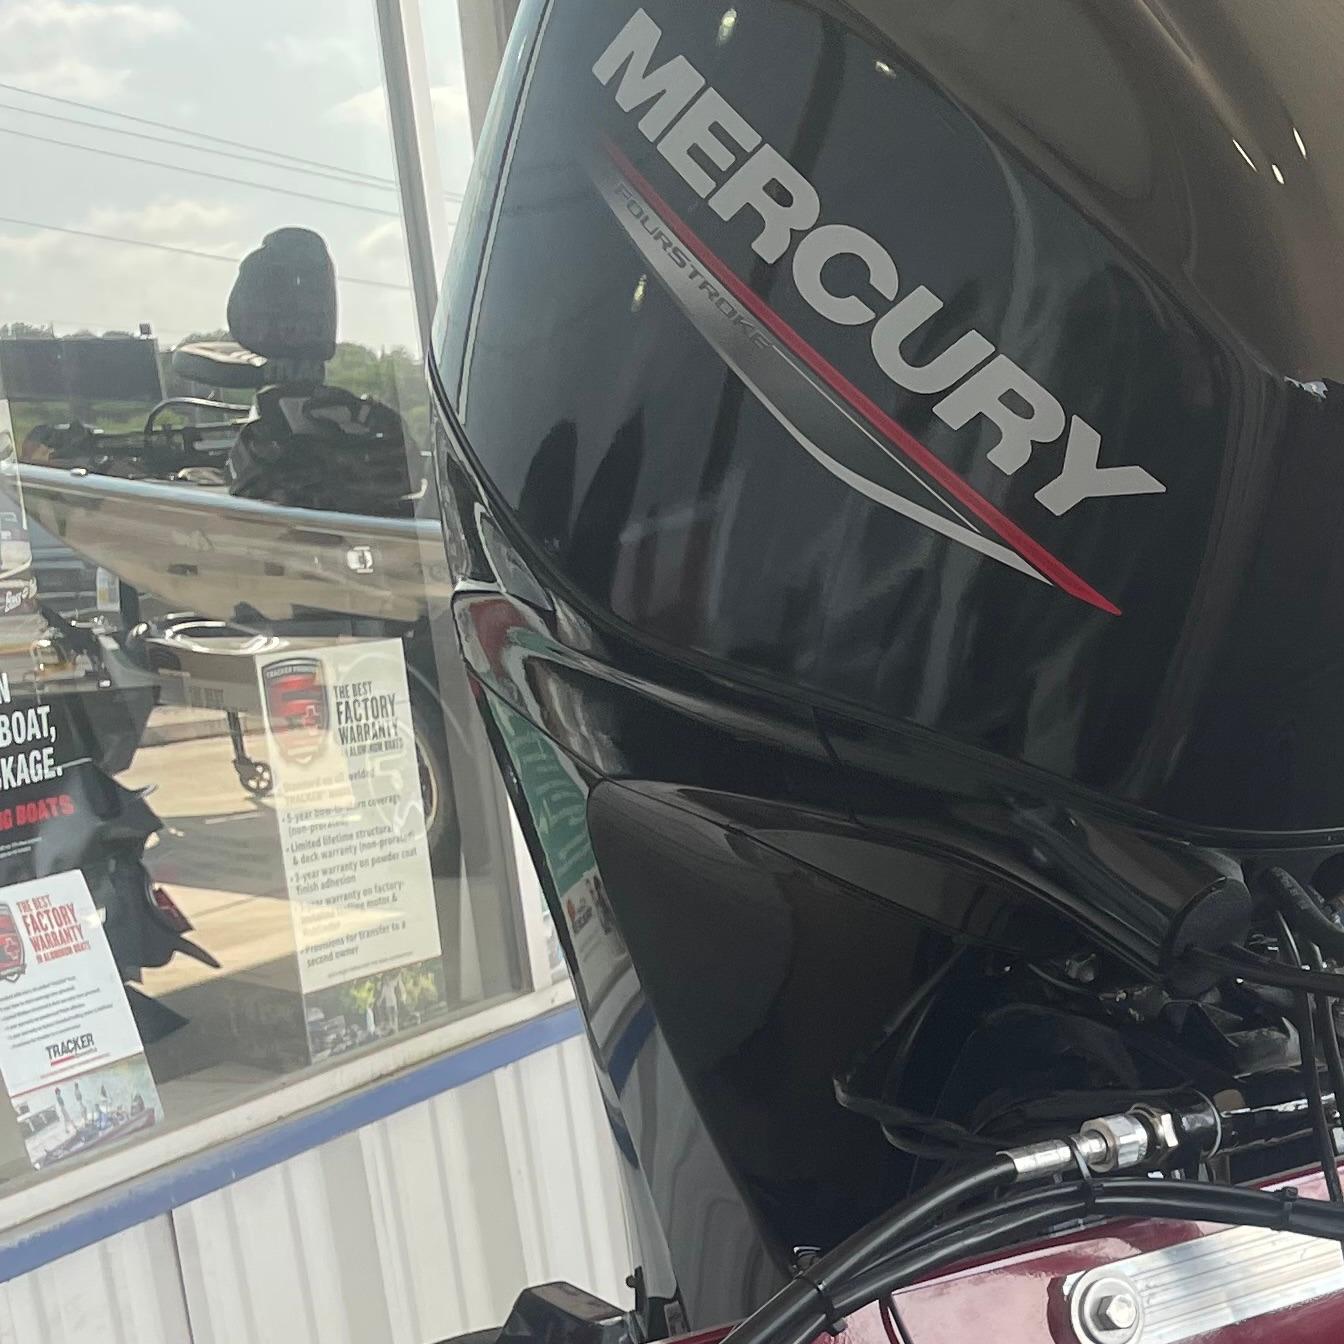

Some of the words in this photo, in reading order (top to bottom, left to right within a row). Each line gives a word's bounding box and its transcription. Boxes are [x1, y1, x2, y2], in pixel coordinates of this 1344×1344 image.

[592, 7, 1167, 517] MERCURY
[334, 685, 350, 698] THE
[352, 681, 373, 697] BEST
[336, 693, 396, 725] FACTORY
[0, 705, 56, 748] BOAT,
[338, 721, 399, 745] WARRANTY
[0, 747, 63, 790] KAGE.
[16, 794, 75, 825] BOATS
[34, 894, 52, 912] BEST
[23, 902, 78, 936] FACTORY
[29, 926, 84, 954] WARRANTY
[46, 1032, 95, 1060] TRACKER
